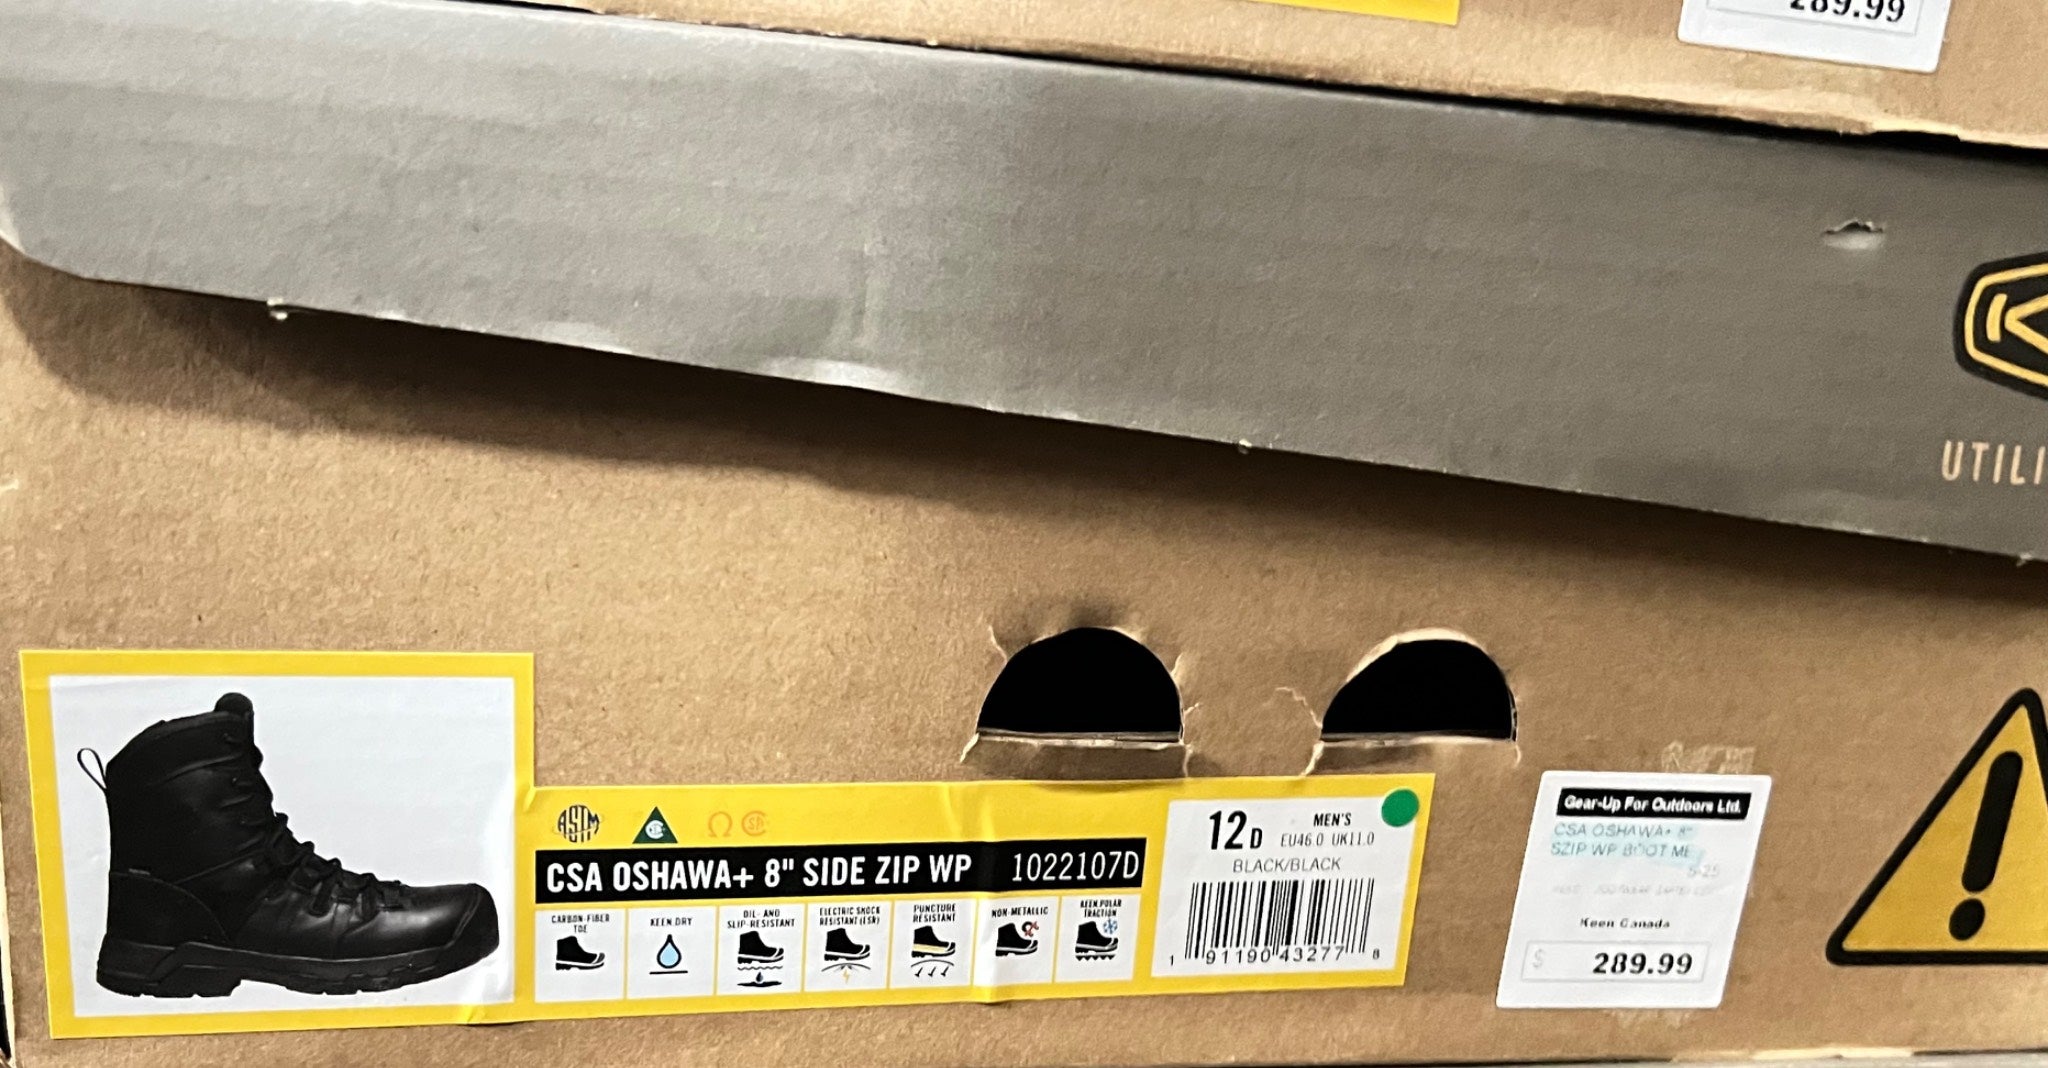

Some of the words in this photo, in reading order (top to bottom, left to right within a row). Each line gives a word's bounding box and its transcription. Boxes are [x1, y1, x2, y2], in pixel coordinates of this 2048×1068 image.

[1564, 795, 1622, 814] Gear-Up
[1625, 796, 1649, 811] For
[1651, 797, 1714, 813] Outdoors
[1717, 799, 1742, 814] Ltd.
[1313, 812, 1351, 827] MEN'S
[1554, 823, 1588, 837] CSA
[1280, 832, 1324, 848] EU46.0
[1331, 831, 1375, 847] UK11.0
[1591, 843, 1618, 858] WP
[1012, 851, 1139, 882] 1022107D
[1233, 857, 1342, 873] BLACK/BLACK
[547, 862, 603, 893] CSA
[613, 859, 754, 891] OSHAWA+
[764, 858, 795, 887] 8"
[803, 856, 865, 886] SIDE
[875, 855, 920, 884] ZIP
[929, 854, 972, 883] WP
[763, 908, 781, 918] AND
[819, 906, 854, 917] ELECTRIC
[856, 905, 881, 915] SHOCK
[913, 903, 956, 913] PUNCTURE
[991, 906, 1049, 918] NON-METALLIC
[1084, 908, 1117, 918] TRACTION
[551, 913, 610, 924] CARBON-FIBER
[727, 918, 795, 929] SLIP-RESISTANT
[819, 915, 857, 926] RESISTANT
[913, 912, 956, 923] RESISTANT
[1580, 917, 1615, 928] Keen
[1620, 918, 1670, 929] Canada
[573, 924, 588, 933] TOE
[1206, 948, 1271, 965] 91190
[1279, 946, 1345, 962] 43277
[1592, 952, 1693, 975] 289.99
